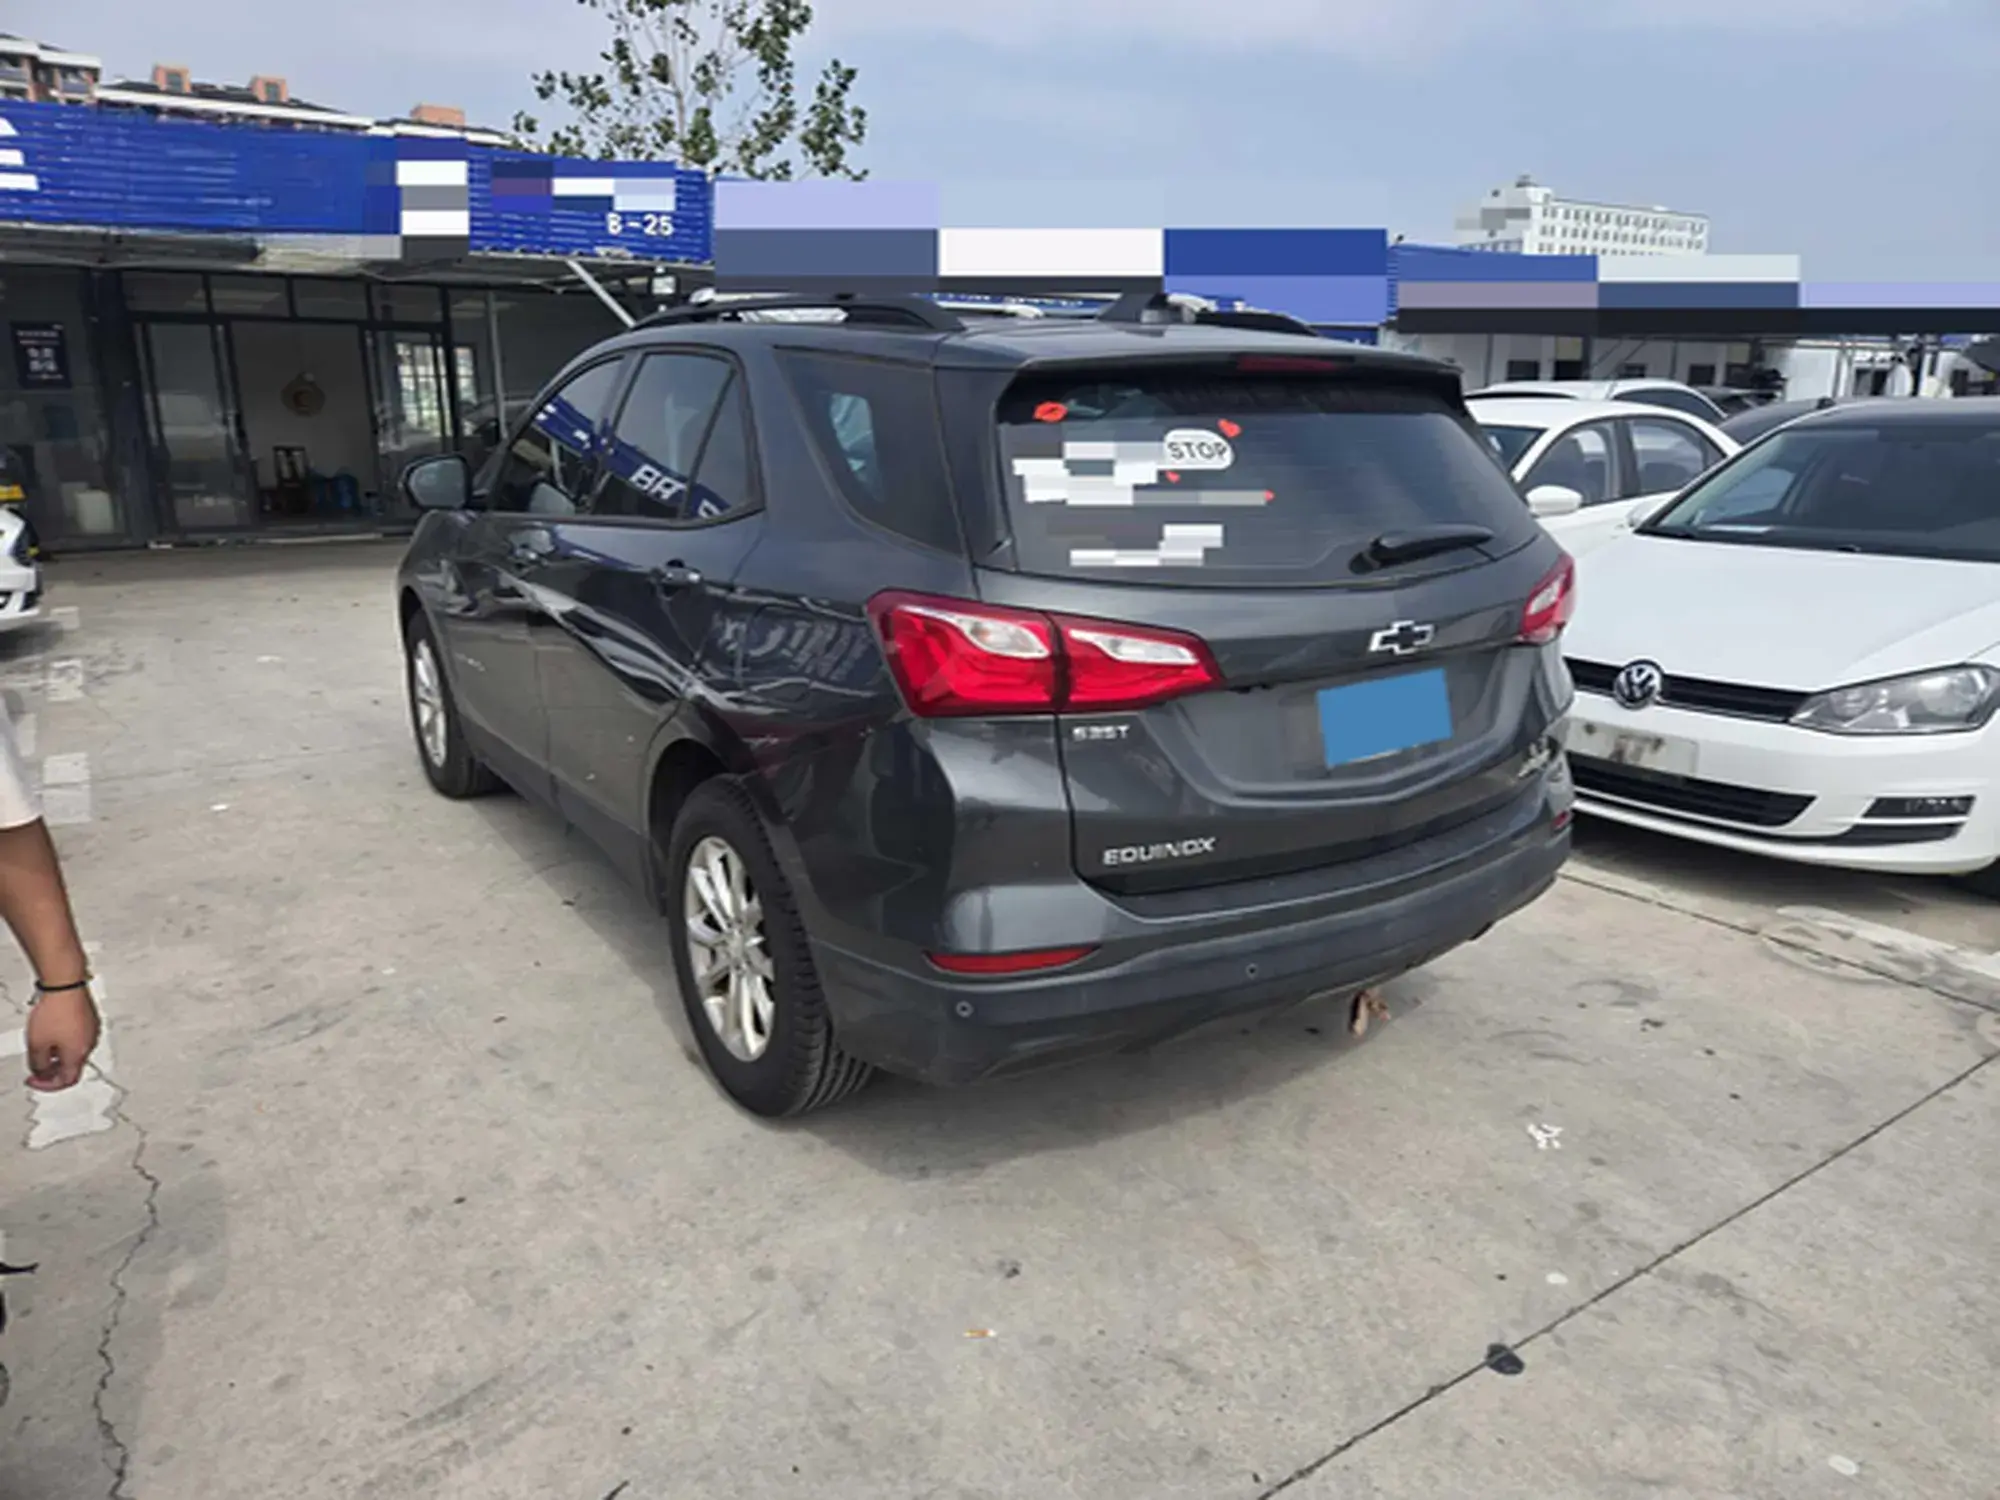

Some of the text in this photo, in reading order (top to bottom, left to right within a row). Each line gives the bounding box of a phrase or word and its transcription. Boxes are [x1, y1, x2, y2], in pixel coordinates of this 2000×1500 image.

[606, 212, 674, 236] B-25
[1167, 441, 1228, 460] STOP
[1103, 836, 1217, 865] EQUINOX
